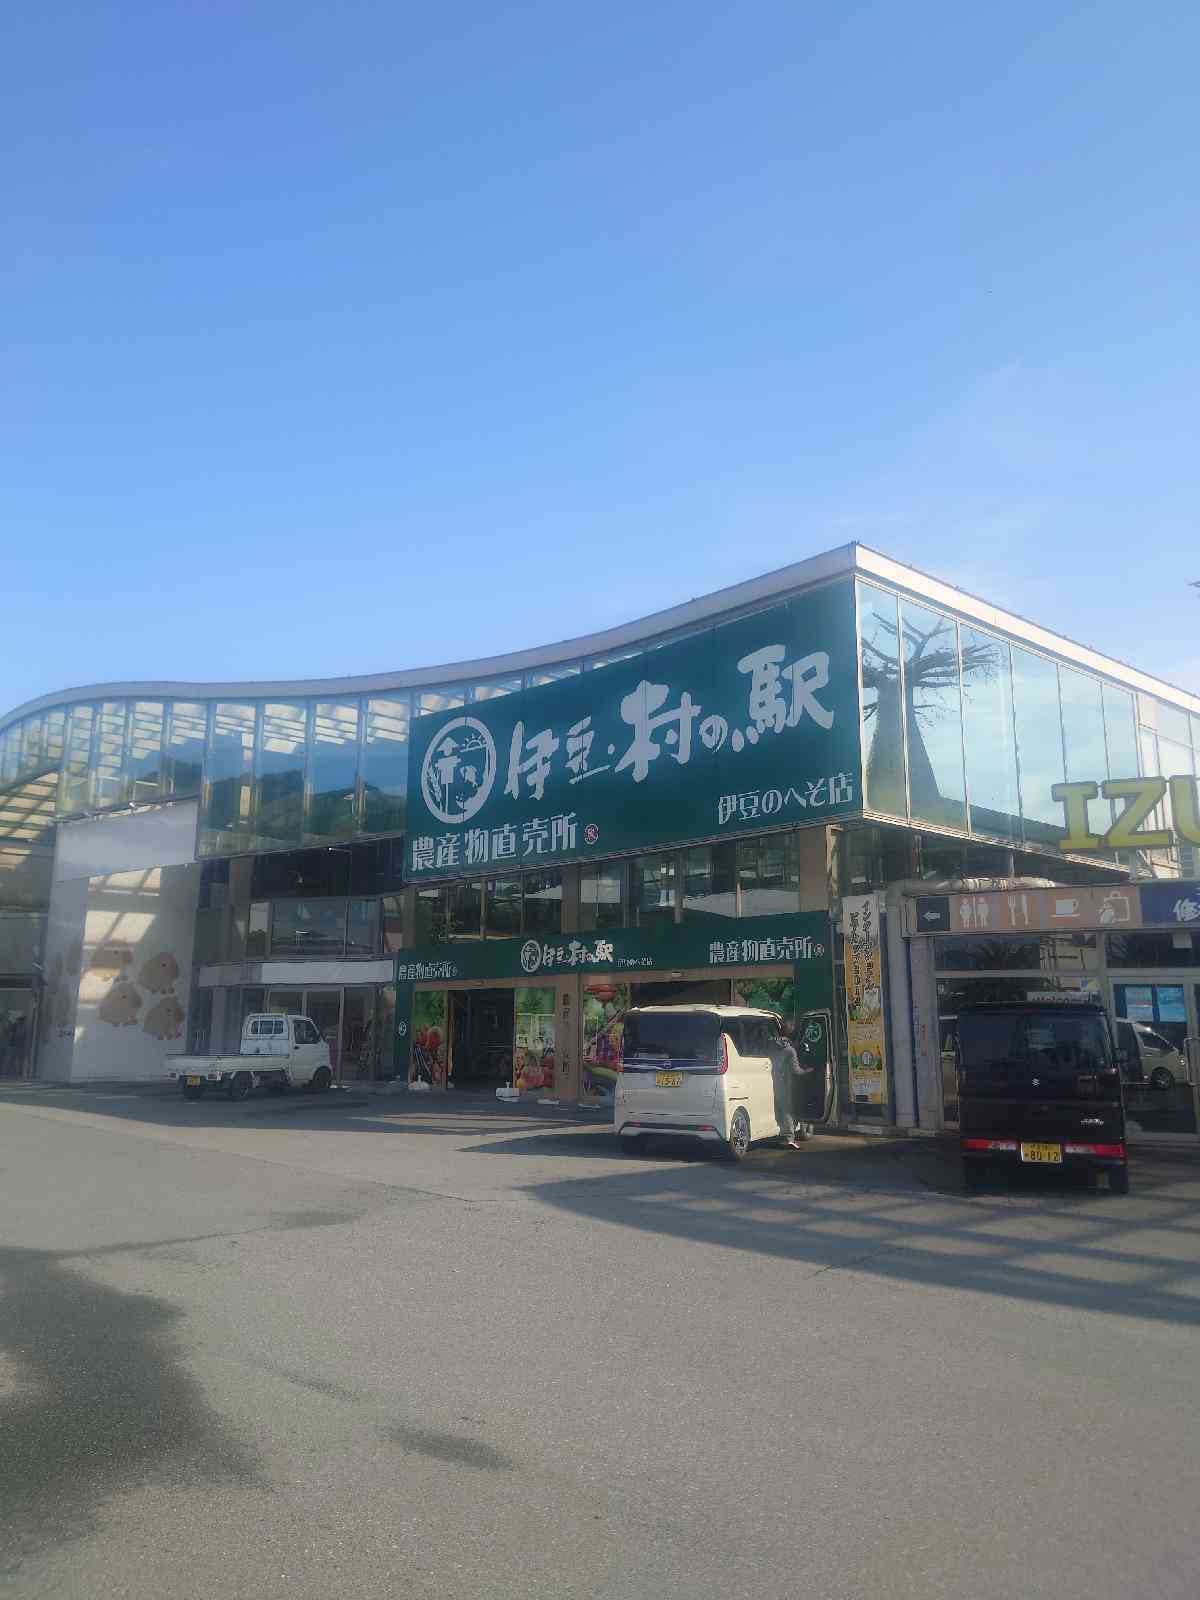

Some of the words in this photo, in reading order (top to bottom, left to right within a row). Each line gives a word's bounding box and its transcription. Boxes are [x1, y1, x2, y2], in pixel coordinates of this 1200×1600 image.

[717, 772, 854, 825] 伊豆のへそ店
[410, 811, 577, 872] 農産物直売所
[709, 936, 812, 963] 農産物直売所
